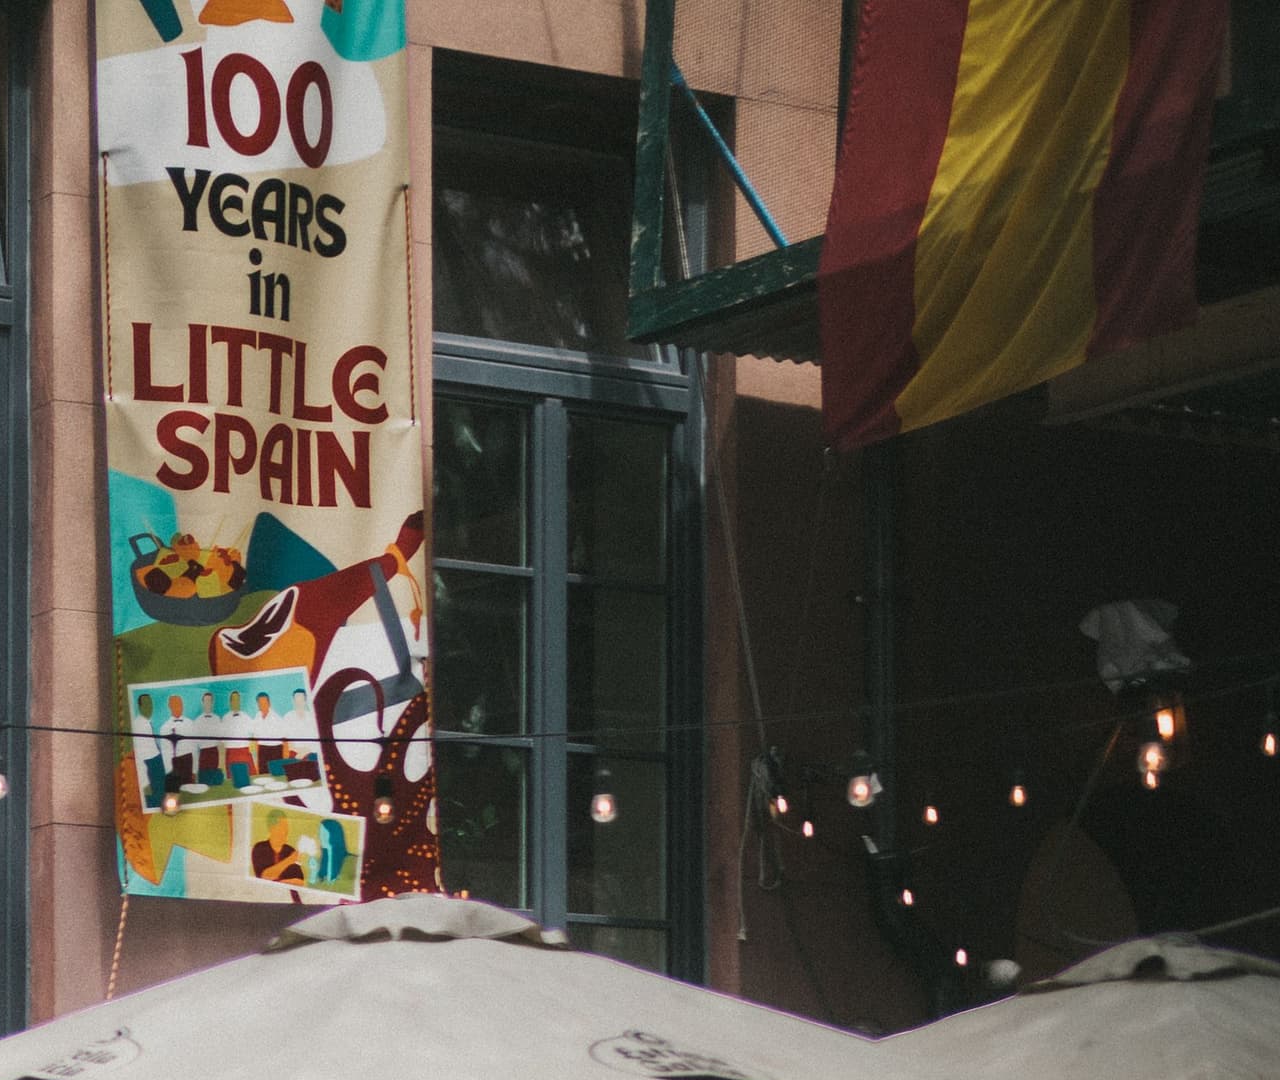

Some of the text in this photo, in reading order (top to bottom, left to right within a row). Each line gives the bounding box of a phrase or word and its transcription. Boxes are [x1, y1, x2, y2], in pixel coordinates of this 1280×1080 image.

[179, 47, 333, 168] 100
[166, 167, 347, 258] YEARS
[247, 248, 291, 322] in
[132, 322, 390, 425] LITTLE
[155, 410, 372, 508] SPAIN
